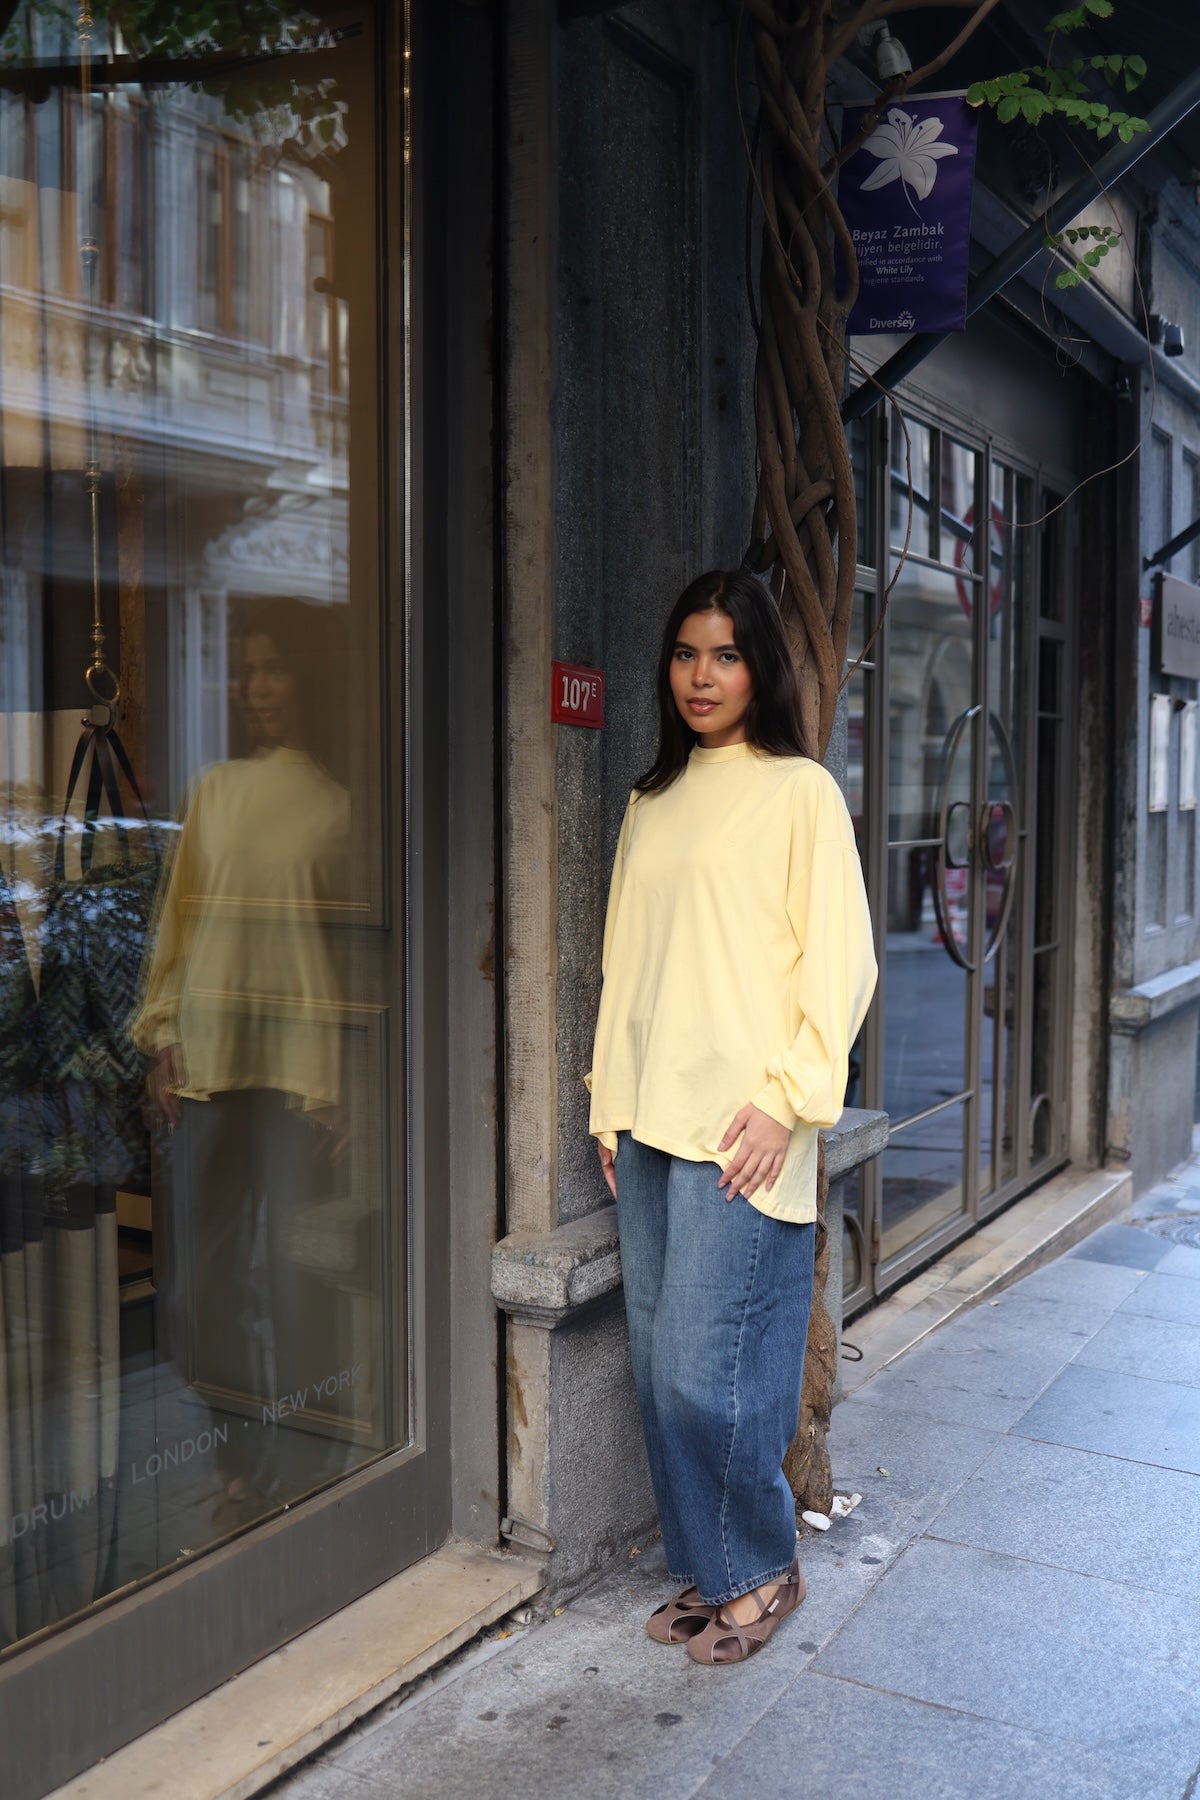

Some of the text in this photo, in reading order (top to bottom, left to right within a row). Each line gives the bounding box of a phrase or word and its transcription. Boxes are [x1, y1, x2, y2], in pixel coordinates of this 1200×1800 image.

[852, 222, 945, 243] Beyaz Zambak
[888, 238, 943, 254] belgelidir.
[887, 256, 926, 265] accordance
[927, 254, 943, 263] with
[876, 265, 914, 276] White Lily
[891, 275, 924, 283] standards
[869, 318, 916, 330] Diversey
[131, 1423, 228, 1485] LONDON
[262, 1387, 308, 1426] NEW
[312, 1361, 363, 1400] YORK
